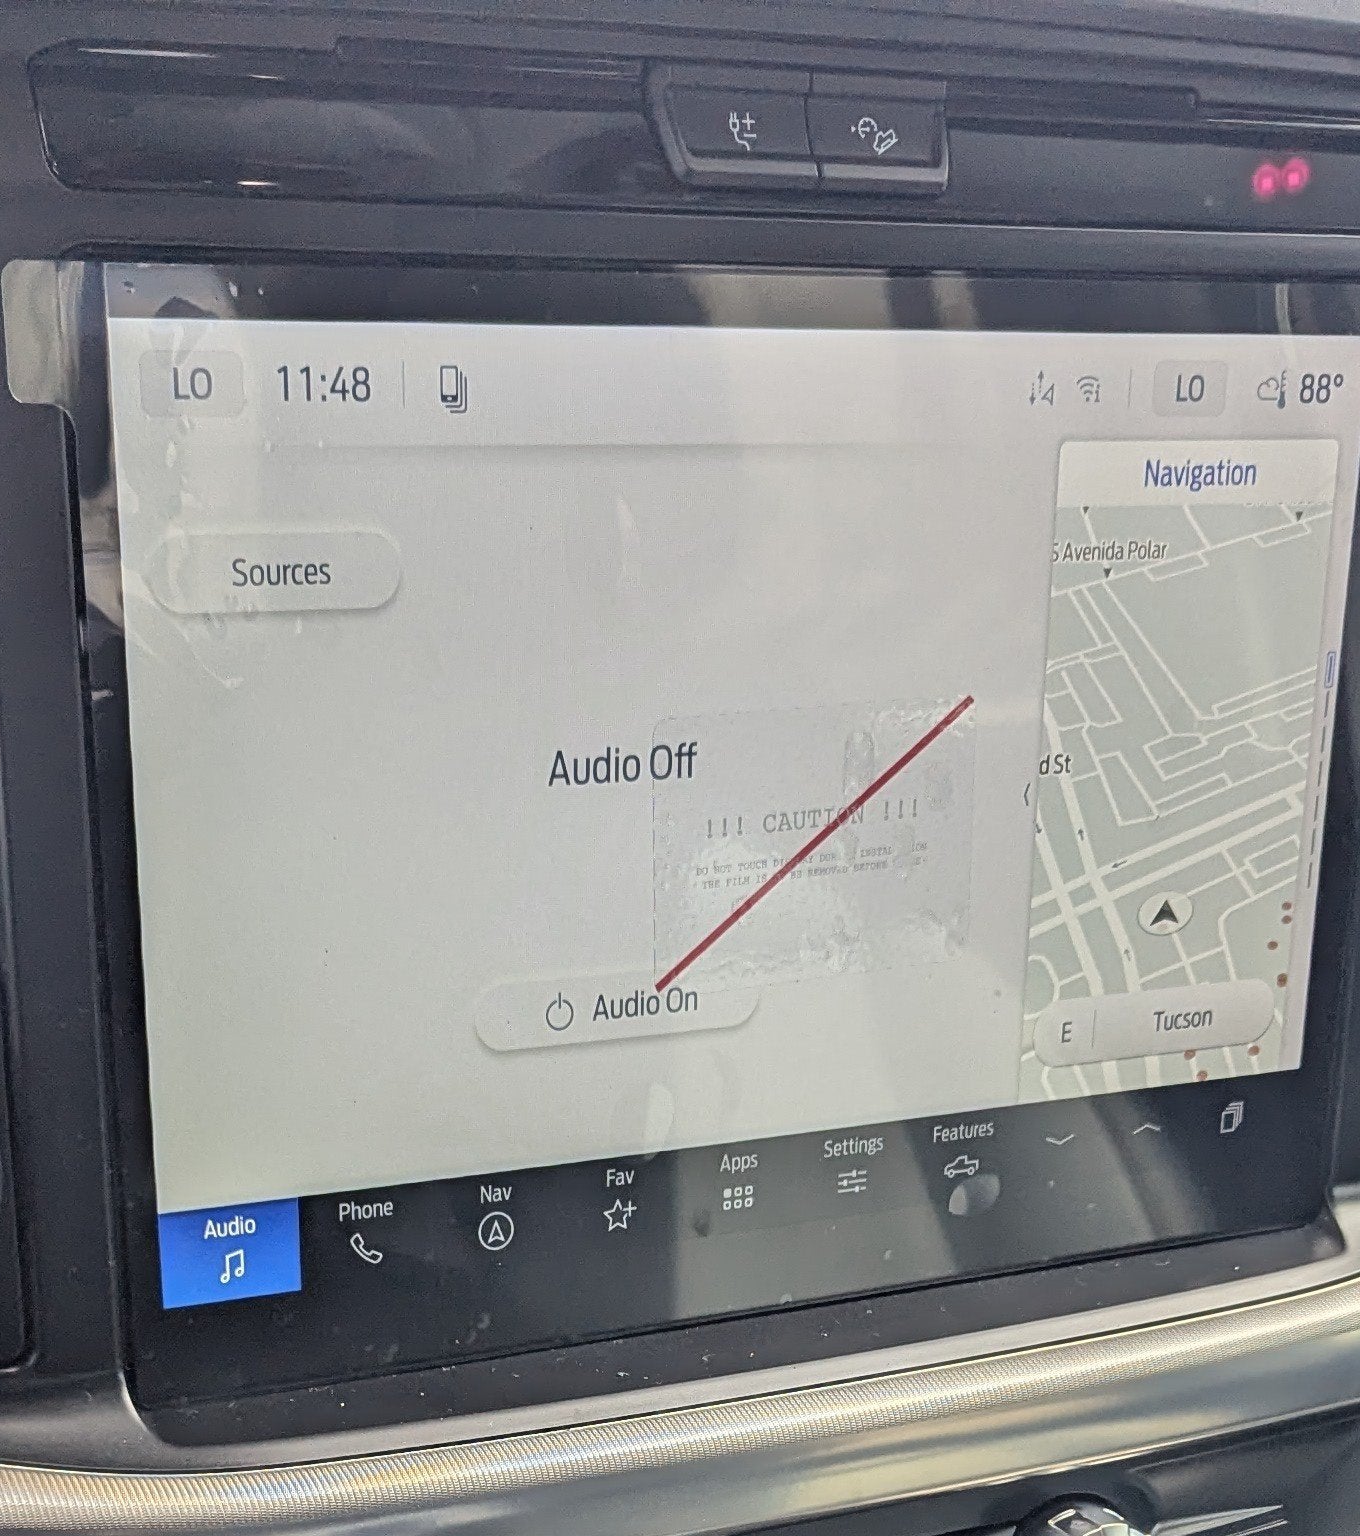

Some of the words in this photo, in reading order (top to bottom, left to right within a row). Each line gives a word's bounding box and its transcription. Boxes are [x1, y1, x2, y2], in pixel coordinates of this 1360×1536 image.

[172, 366, 213, 400] LO
[277, 366, 372, 403] 11:48
[1176, 375, 1206, 403] LO
[1299, 373, 1345, 405] 88°
[1143, 459, 1258, 493] Navigation
[1062, 541, 1125, 562] Avenida
[1128, 540, 1168, 560] Polar
[232, 558, 332, 589] Sources
[548, 746, 642, 787] Audio
[649, 741, 700, 781] Off
[1053, 754, 1072, 775] St
[592, 988, 661, 1022] Audio
[666, 988, 700, 1014] On
[1060, 1021, 1073, 1044] E
[1153, 1007, 1214, 1034] Tucson
[933, 1120, 995, 1144] Features
[823, 1134, 885, 1161] Settings
[720, 1150, 760, 1174] Apps
[606, 1167, 636, 1187] Fav
[480, 1183, 513, 1204] Nav
[339, 1198, 395, 1223] Phone
[204, 1215, 257, 1239] Audio
